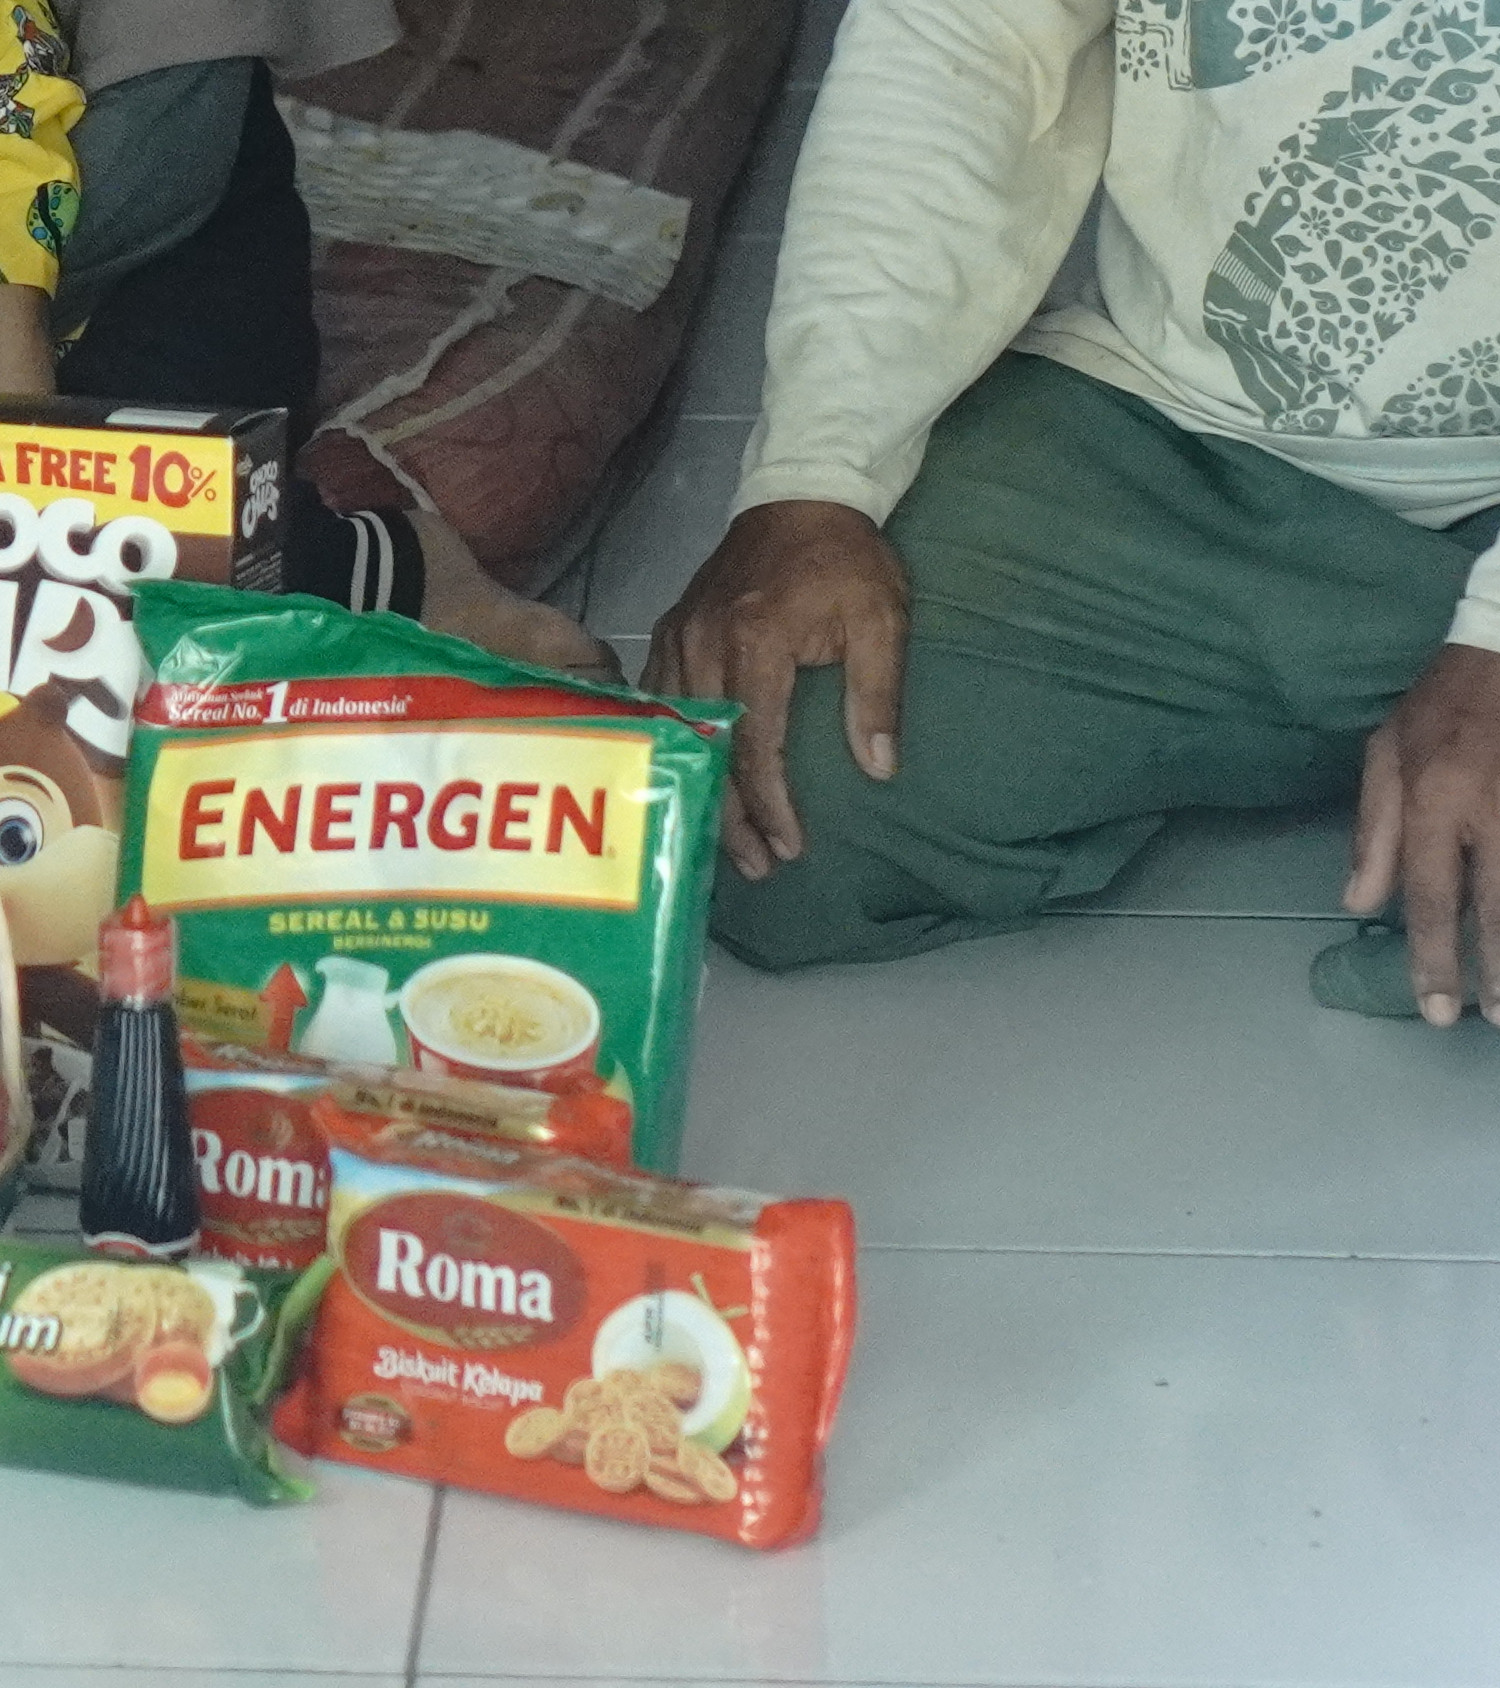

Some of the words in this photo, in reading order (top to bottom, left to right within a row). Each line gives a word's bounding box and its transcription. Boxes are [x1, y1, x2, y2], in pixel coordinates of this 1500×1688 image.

[15, 442, 118, 496] FREE
[129, 444, 217, 509] 10%
[262, 680, 290, 724] 1
[290, 698, 309, 716] di
[179, 778, 607, 861] ENERGEN
[268, 909, 380, 935] SEREAL
[413, 909, 490, 933] SUSU
[190, 1127, 325, 1209] Rom
[377, 1227, 554, 1324] Roma
[373, 1345, 460, 1388] Biskuit
[463, 1362, 544, 1408] Kelapa
